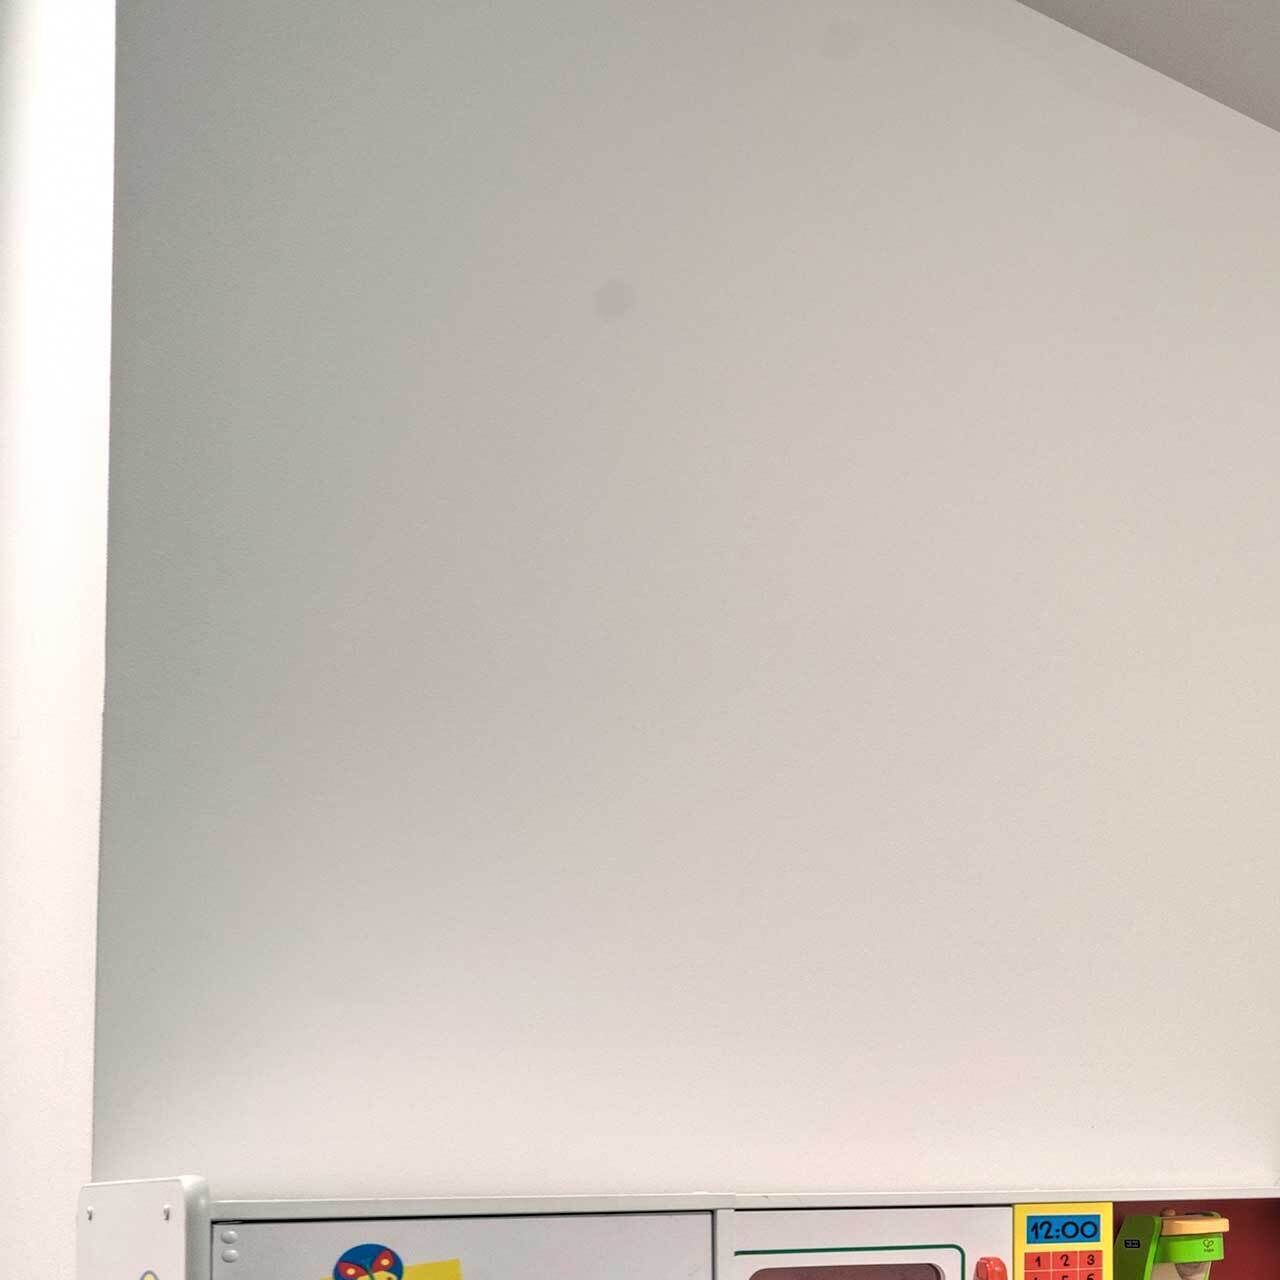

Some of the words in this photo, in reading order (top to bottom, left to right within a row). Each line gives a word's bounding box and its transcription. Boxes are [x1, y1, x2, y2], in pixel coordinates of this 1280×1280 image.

[1031, 1221, 1098, 1239] 12:00
[1034, 1256, 1041, 1267] 1
[1060, 1255, 1070, 1266] 2
[1087, 1254, 1095, 1266] 3
